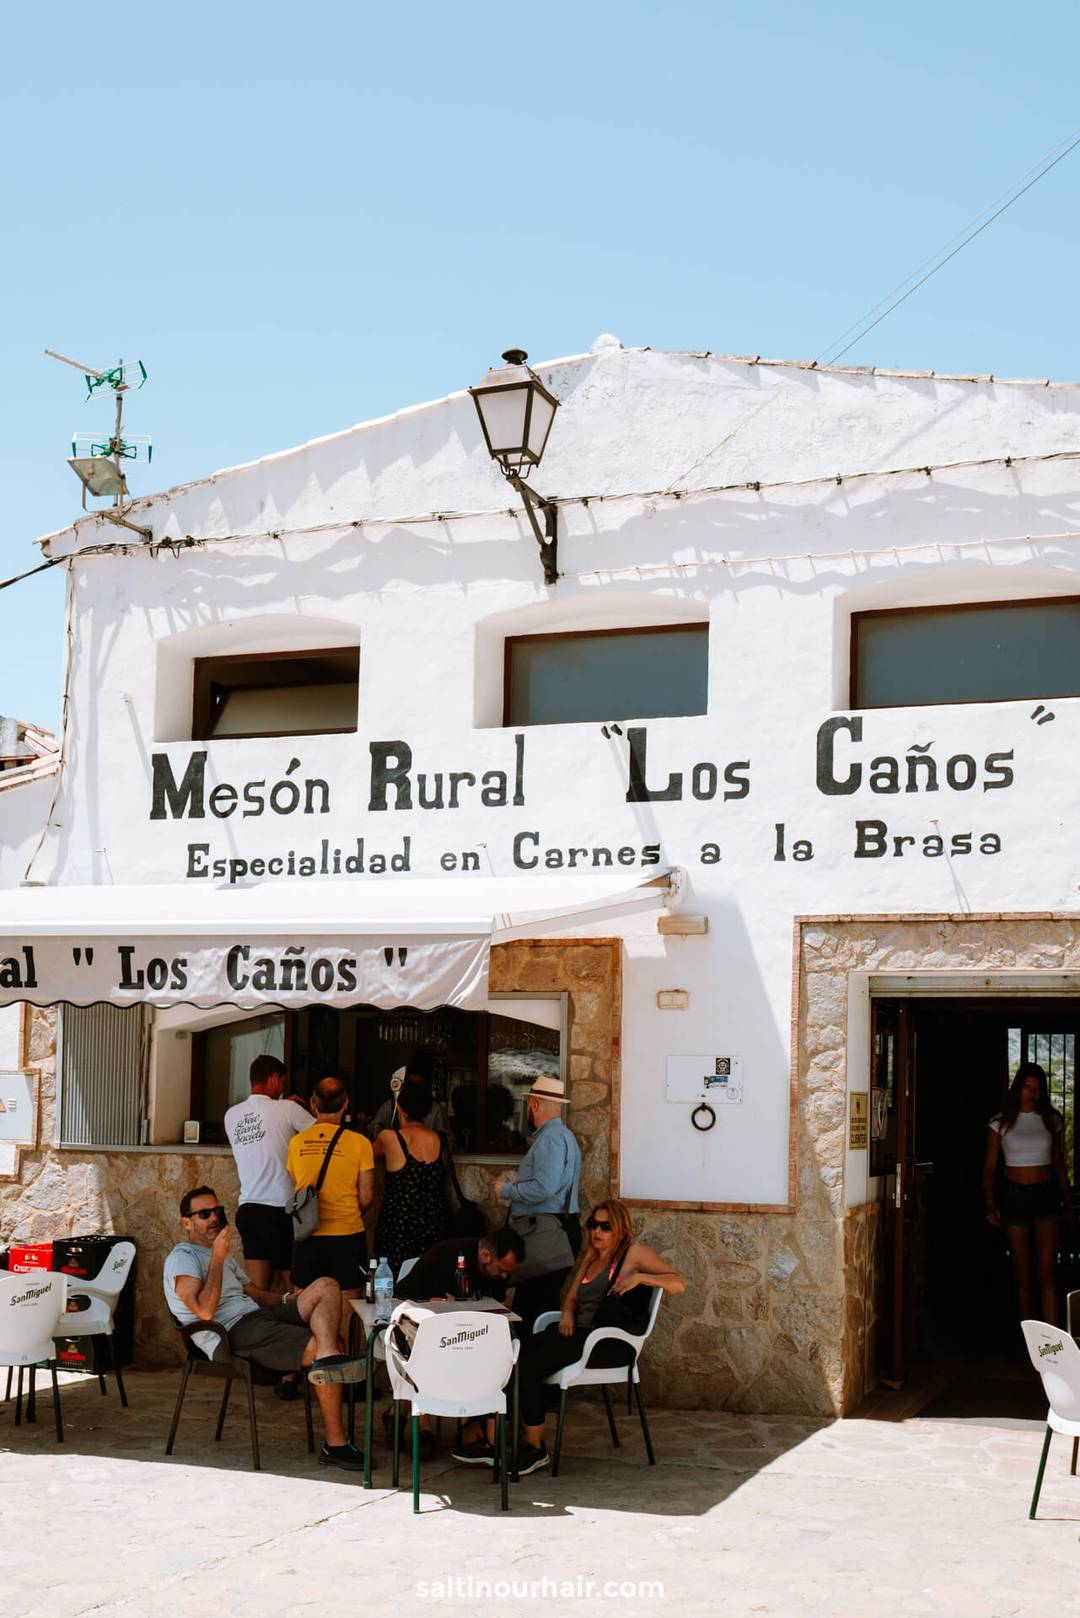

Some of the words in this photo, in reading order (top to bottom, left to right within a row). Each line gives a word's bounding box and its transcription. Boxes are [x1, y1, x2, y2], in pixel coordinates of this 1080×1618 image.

[149, 750, 330, 820] Mesón
[368, 733, 526, 811] Rural
[186, 836, 411, 884] Especialidad
[440, 852, 480, 871] en
[513, 831, 661, 870] Carnes
[700, 843, 721, 865] a
[774, 823, 814, 862] la
[854, 819, 1001, 859] Brasa
[117, 945, 188, 991] Los
[226, 944, 357, 993] Caños
